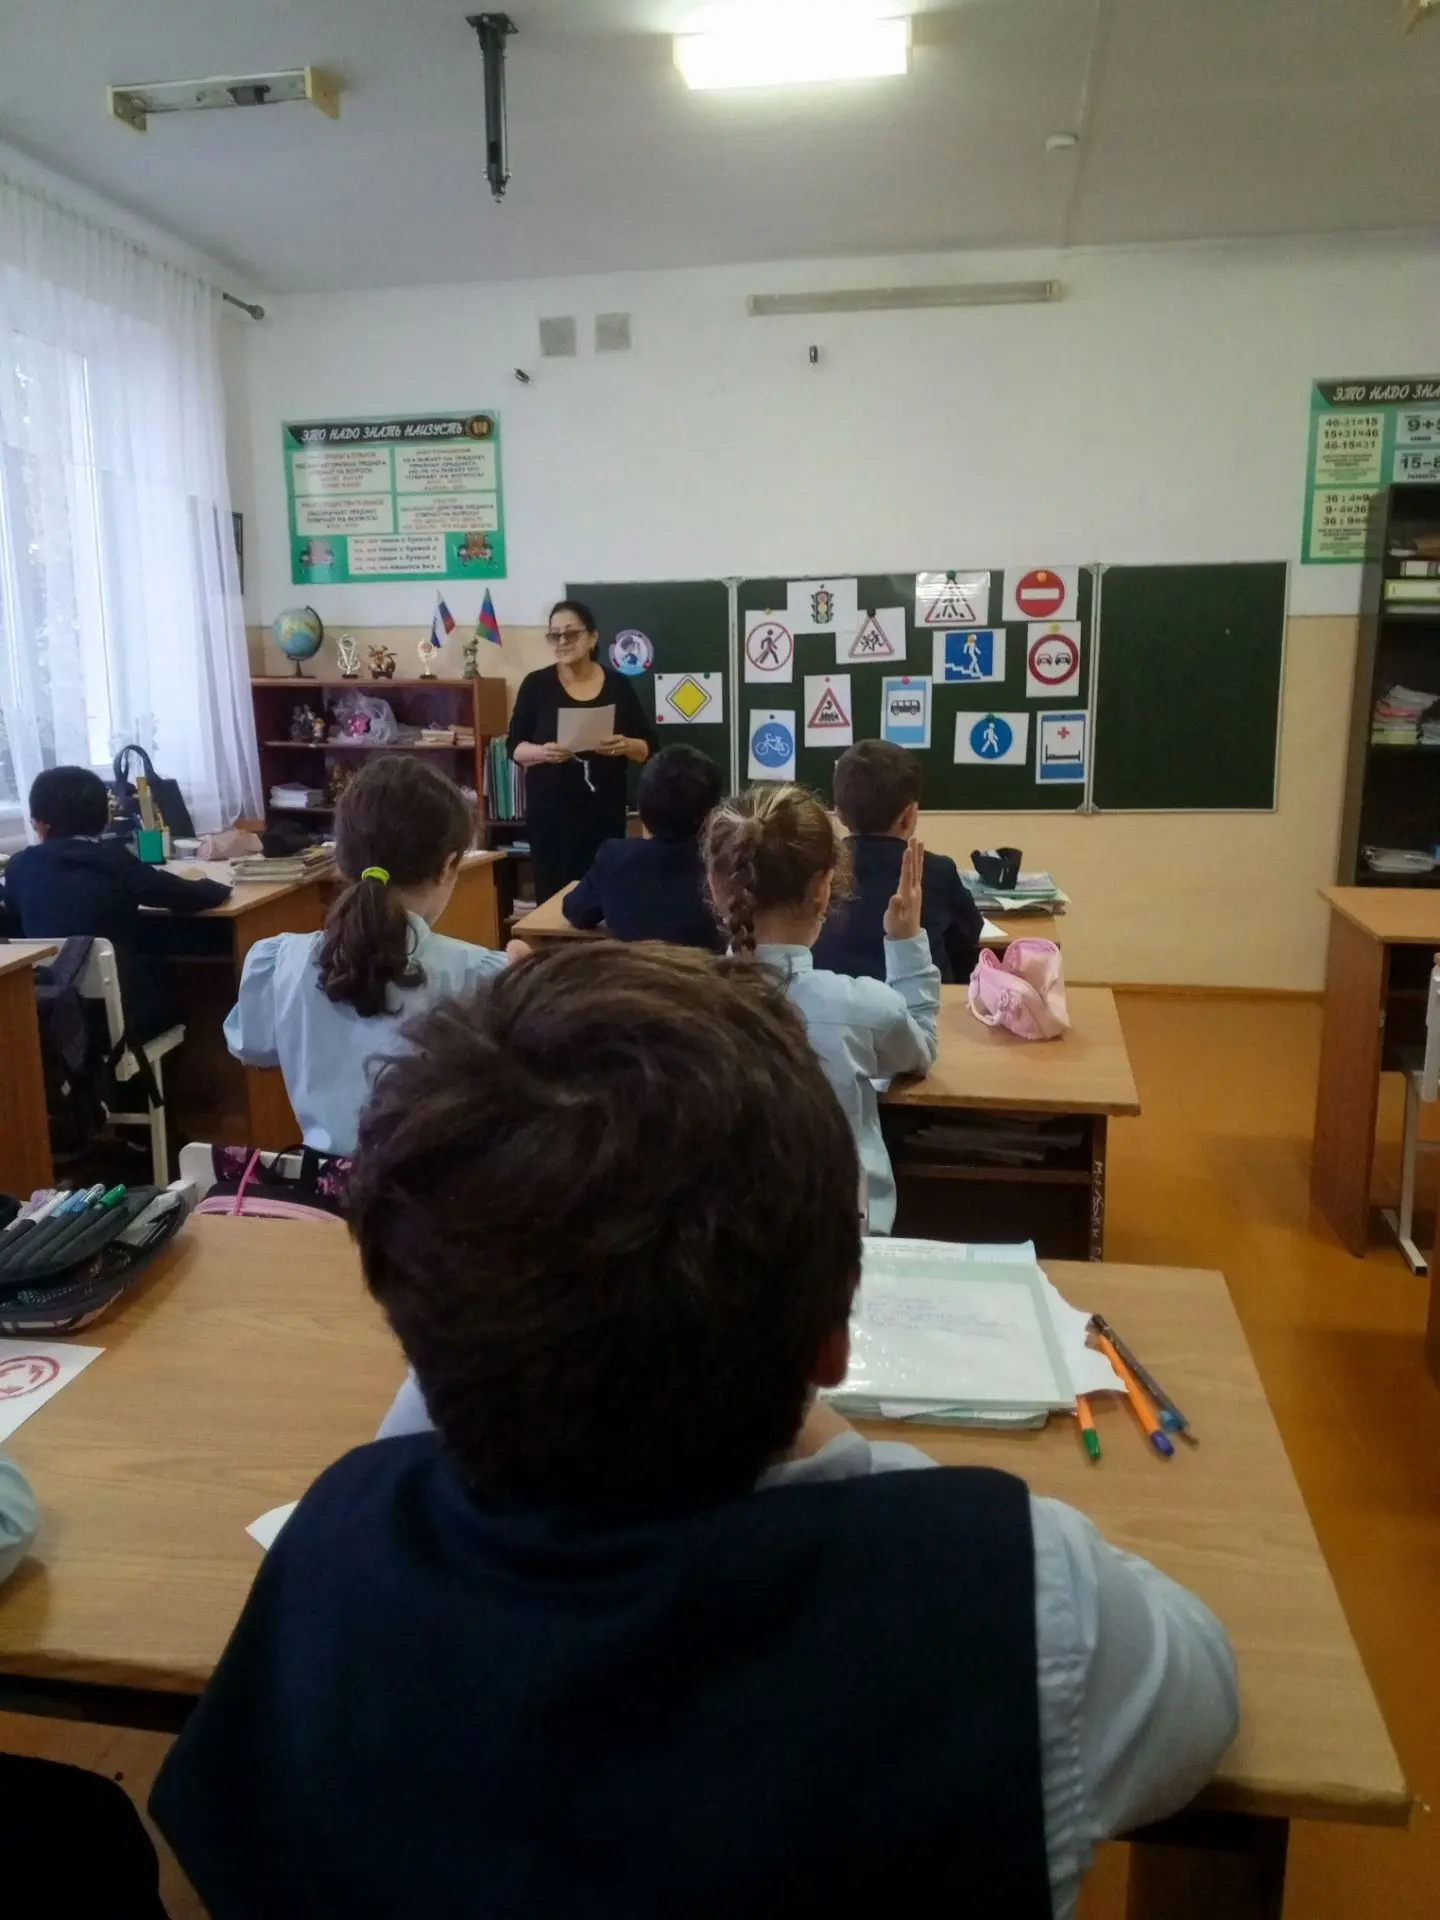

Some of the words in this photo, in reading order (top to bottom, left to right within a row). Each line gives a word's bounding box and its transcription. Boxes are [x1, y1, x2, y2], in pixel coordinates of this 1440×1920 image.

[1333, 386, 1366, 401] ЭТО
[1369, 384, 1410, 400] НАДО
[300, 428, 326, 441] ЭТО
[329, 427, 360, 441] НАДО
[362, 425, 401, 439] ЗНАТЬ
[404, 423, 463, 437] НАИЗУСТЬ
